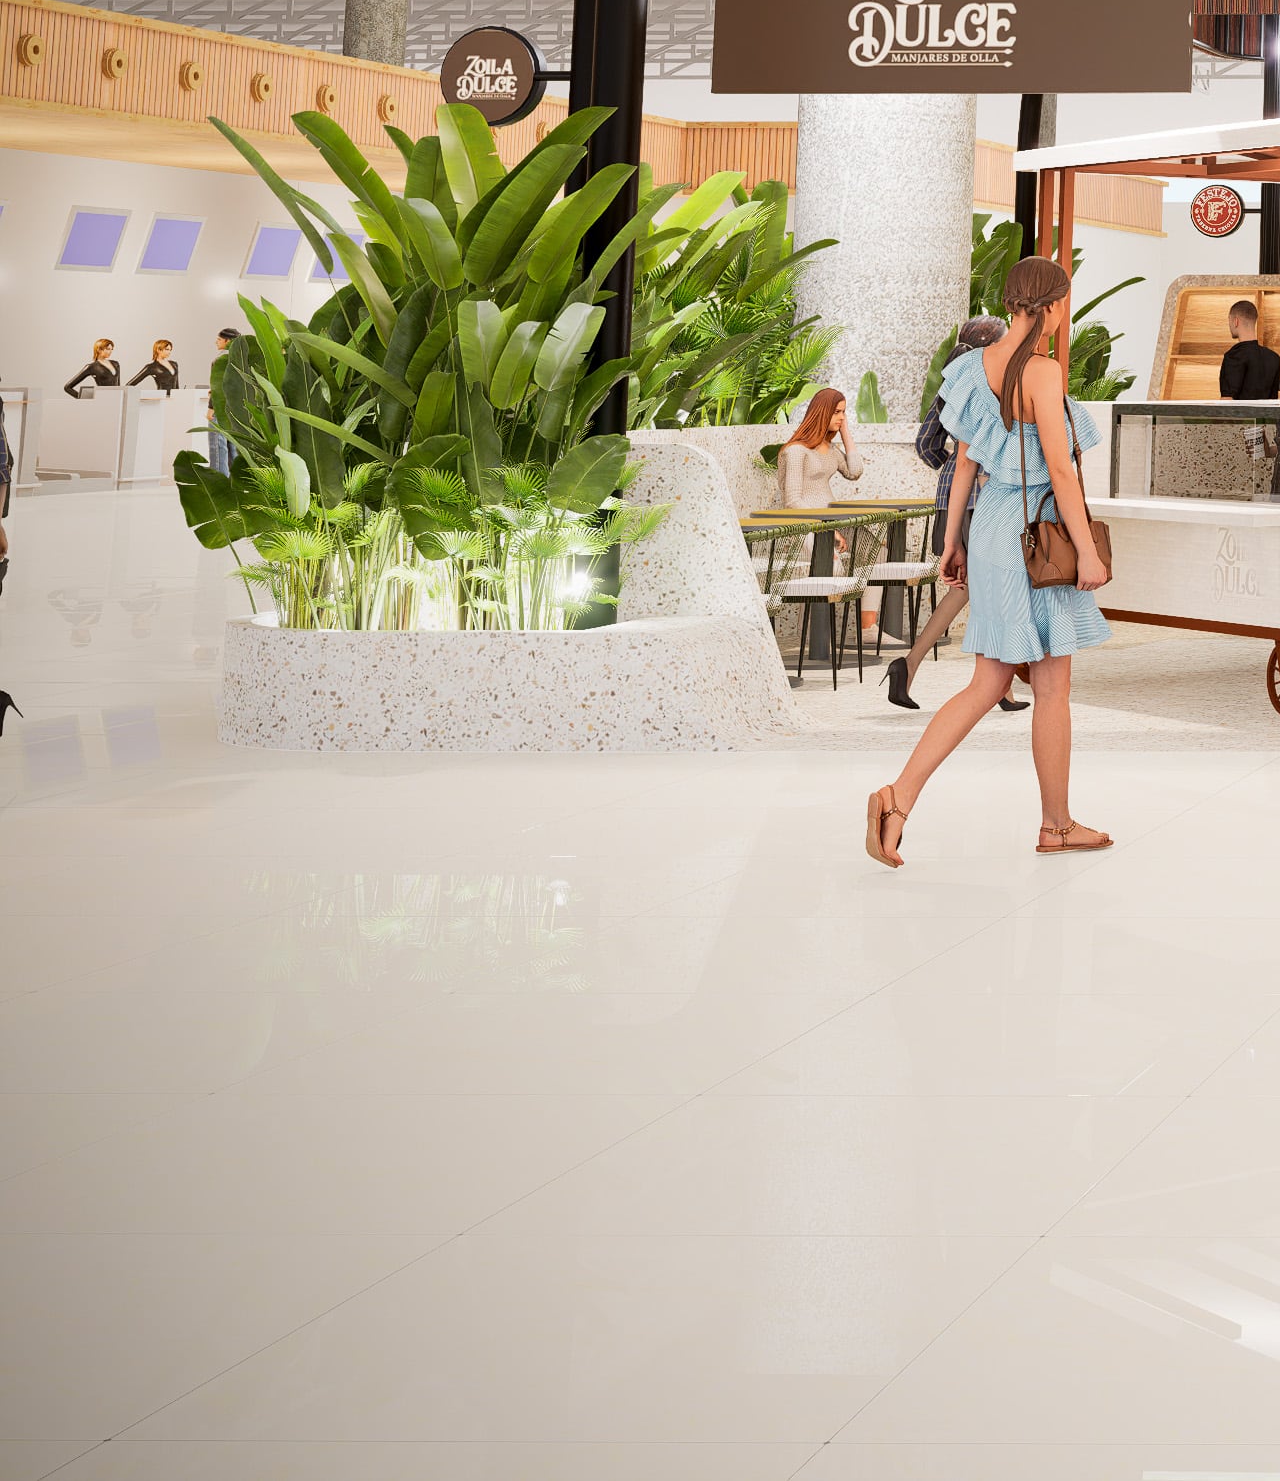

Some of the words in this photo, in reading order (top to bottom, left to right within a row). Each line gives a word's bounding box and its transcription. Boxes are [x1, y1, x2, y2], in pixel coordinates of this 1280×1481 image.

[848, 1, 1017, 67] DULCE
[463, 55, 514, 77] ZOILA
[891, 53, 949, 64] MANJARES
[952, 53, 967, 63] DE
[972, 53, 1000, 63] OLLA
[456, 75, 518, 100] DULCE
[1195, 188, 1238, 207] FESTEJO
